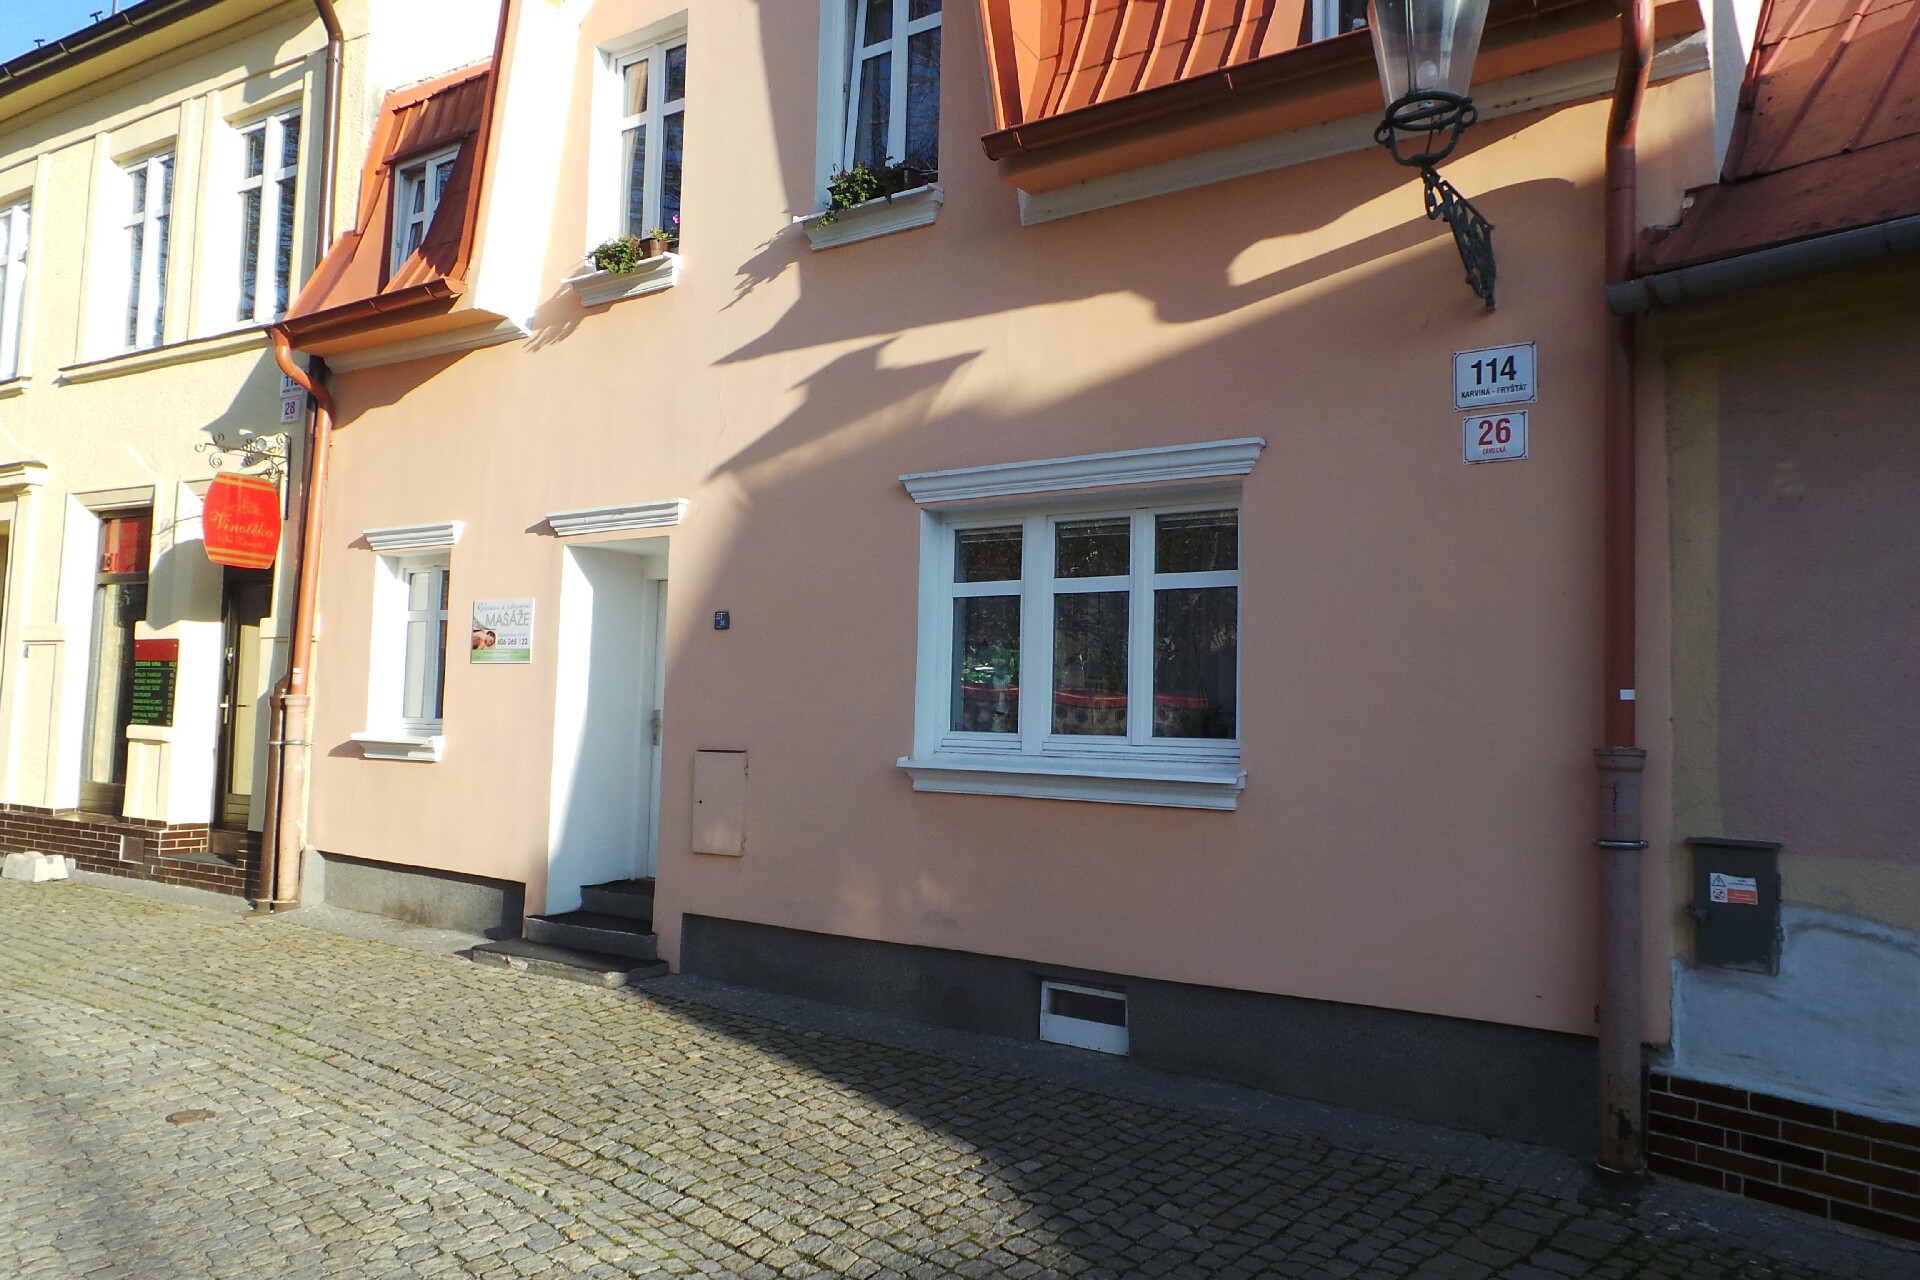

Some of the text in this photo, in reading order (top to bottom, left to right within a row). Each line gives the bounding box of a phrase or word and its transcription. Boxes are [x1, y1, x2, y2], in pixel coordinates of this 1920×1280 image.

[1471, 355, 1517, 385] 114
[1461, 387, 1491, 399] KARVINÁ
[1496, 383, 1528, 395] FRYŠTÁT
[285, 401, 296, 415] 28
[1478, 418, 1511, 446] 26
[485, 609, 530, 626] MASÁŽE
